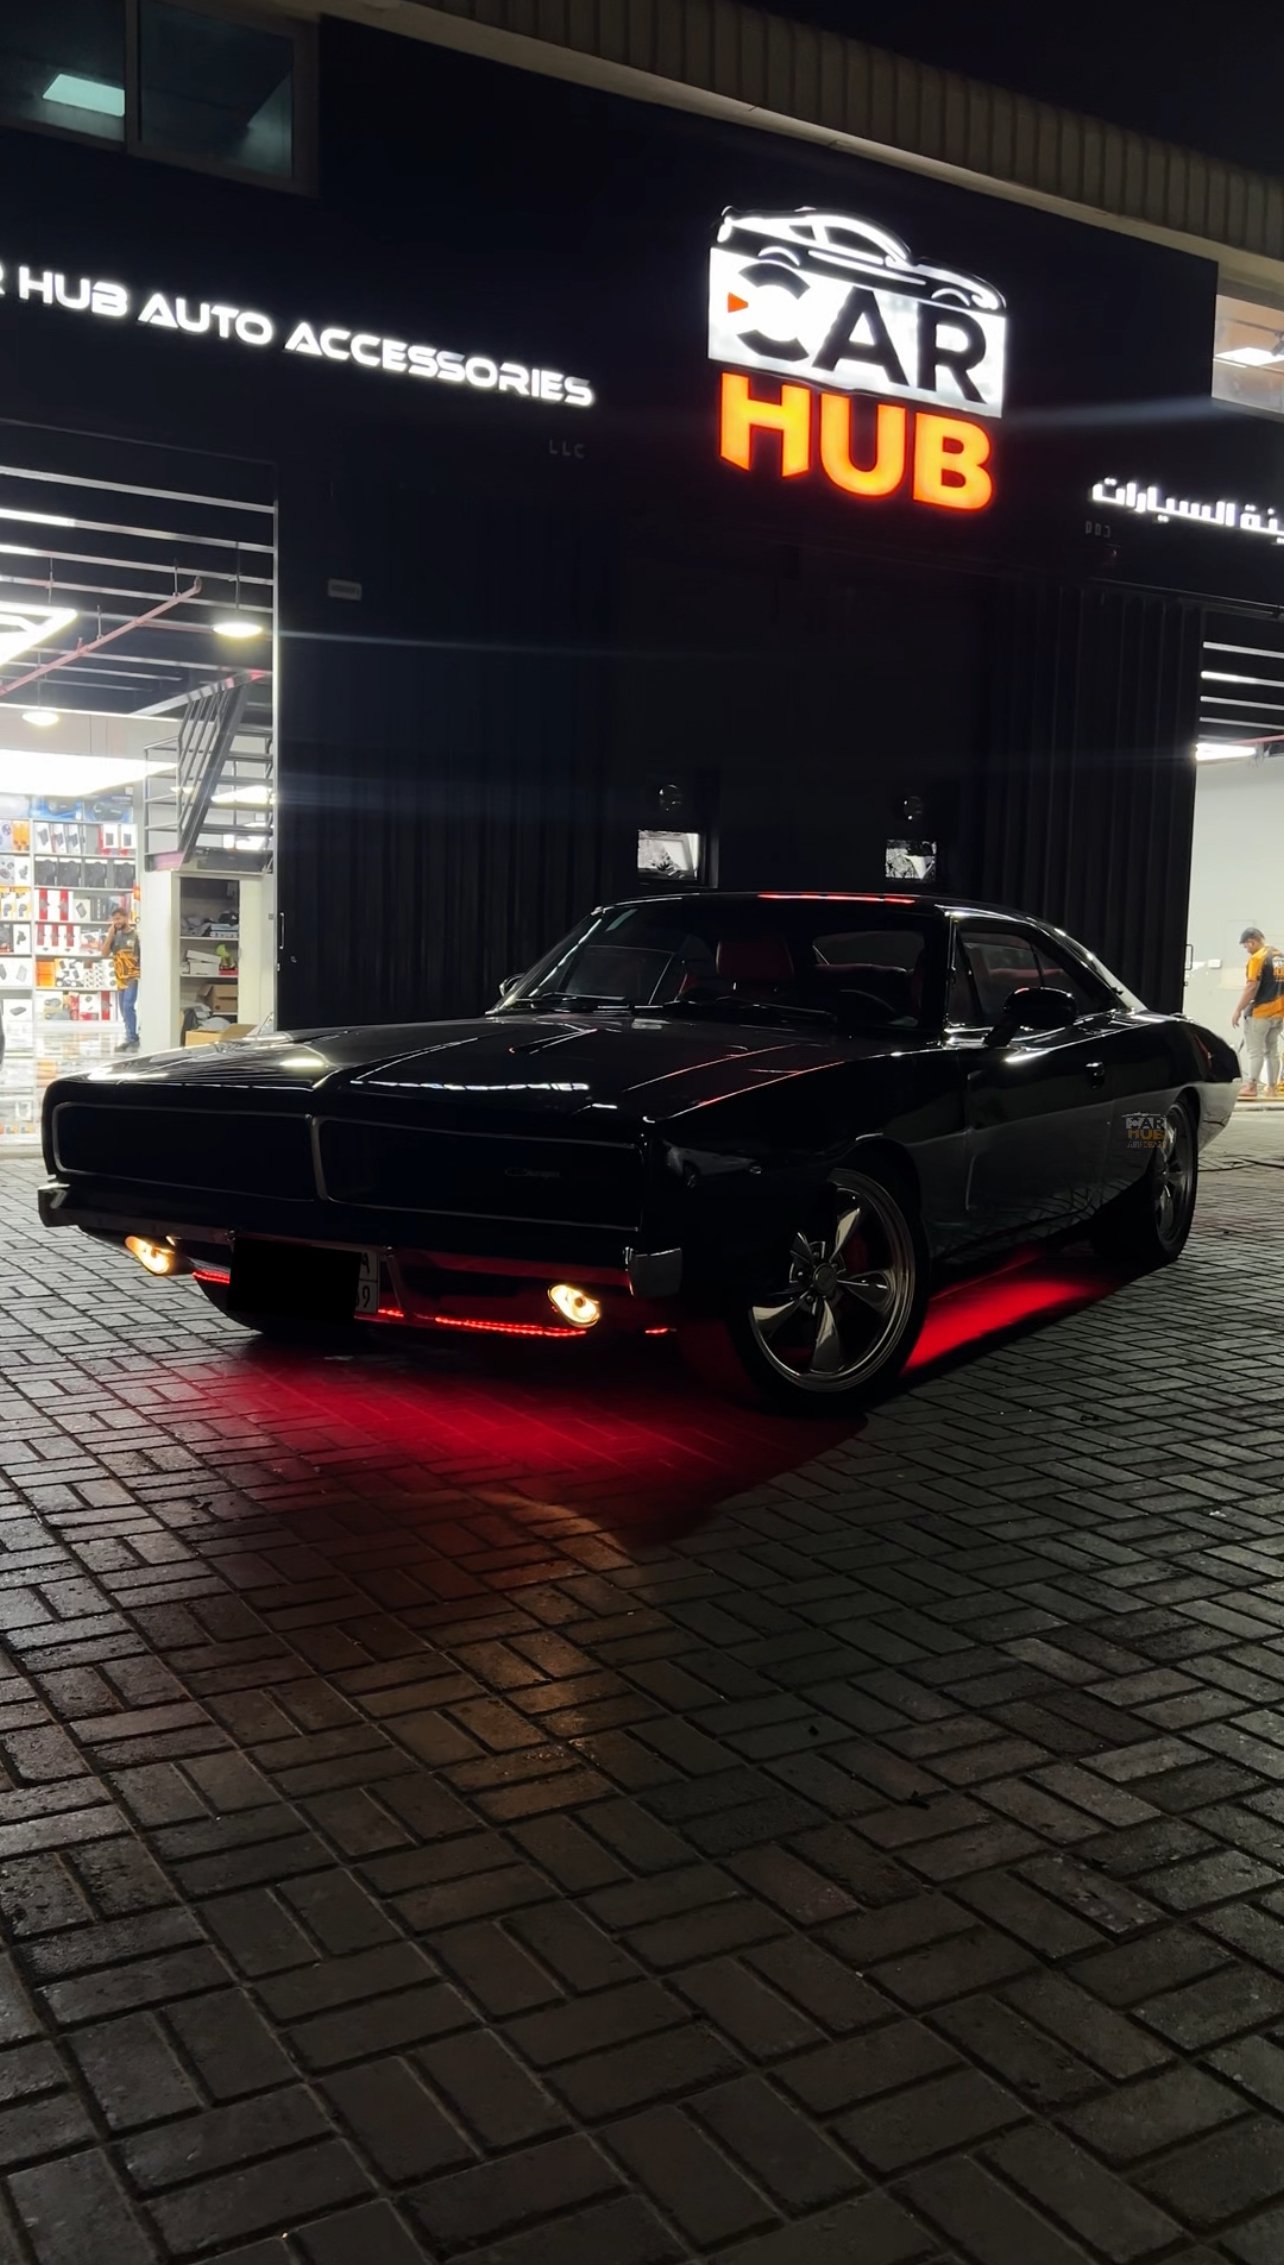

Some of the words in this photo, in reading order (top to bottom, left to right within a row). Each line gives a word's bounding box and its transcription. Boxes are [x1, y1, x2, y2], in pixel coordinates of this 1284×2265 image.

[18, 266, 129, 317] HUB
[138, 292, 274, 345] AUTO
[285, 321, 594, 406] ACCESSORIES
[728, 260, 988, 404] CAR
[719, 372, 994, 511] HUB
[1092, 478, 1234, 528] السيارات
